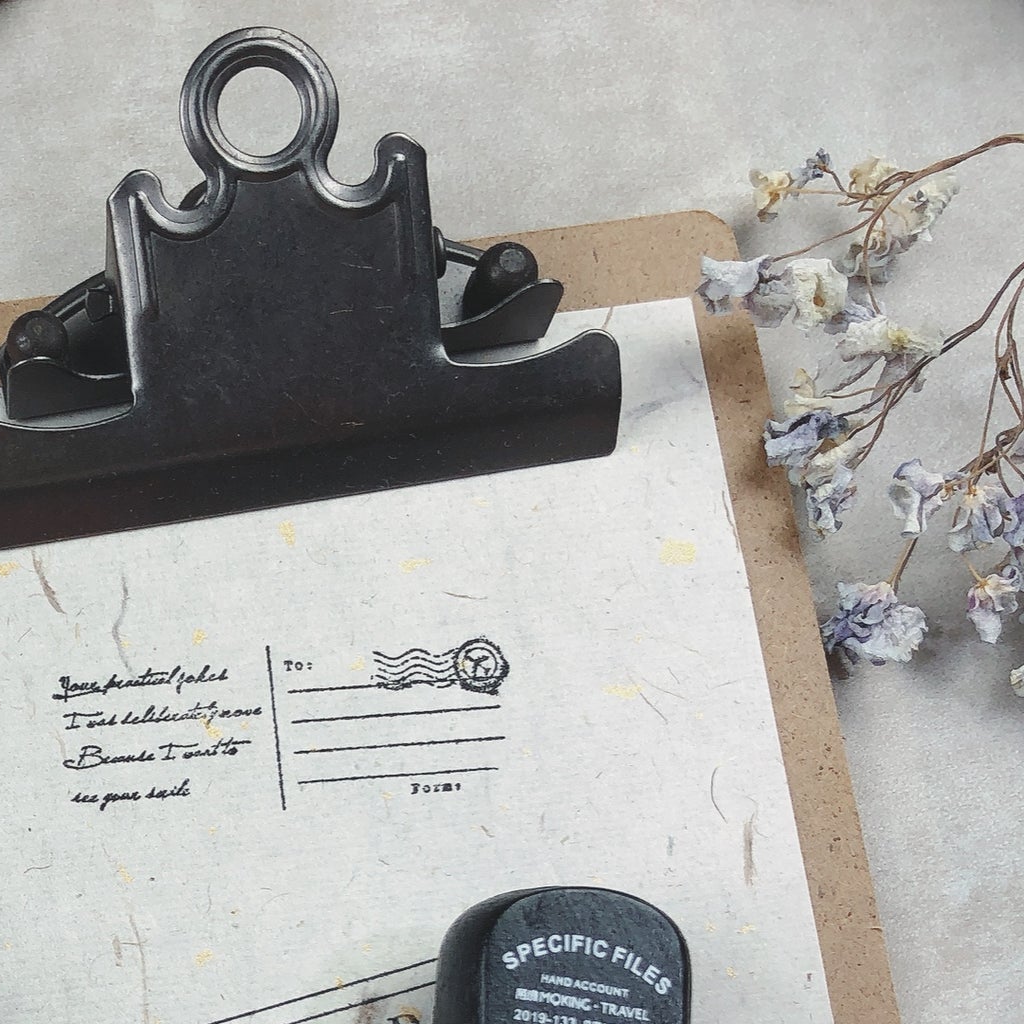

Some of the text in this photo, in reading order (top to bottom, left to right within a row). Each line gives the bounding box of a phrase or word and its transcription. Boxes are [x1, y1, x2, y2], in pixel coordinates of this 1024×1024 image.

[502, 934, 672, 995] SPECIFIC FILES
[540, 973, 629, 998] HAND ACCOUNT
[600, 1002, 651, 1022] TRAVEL
